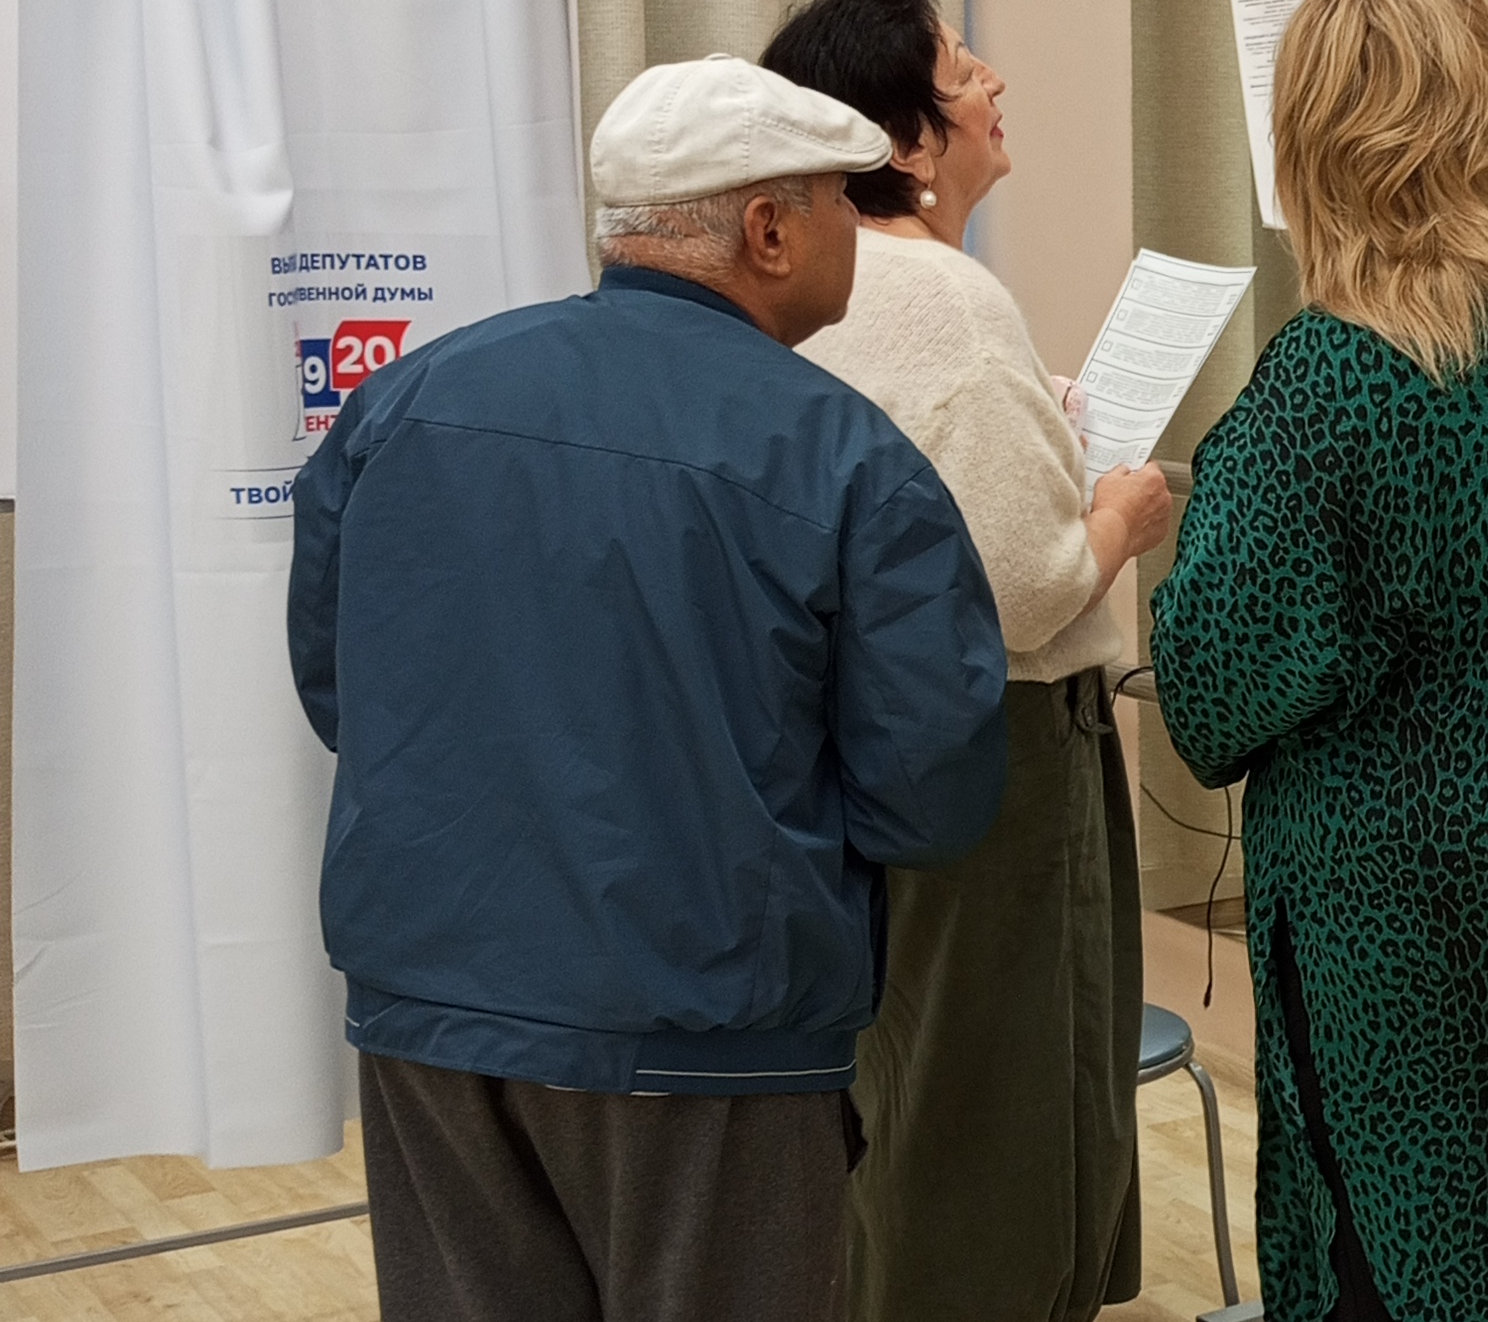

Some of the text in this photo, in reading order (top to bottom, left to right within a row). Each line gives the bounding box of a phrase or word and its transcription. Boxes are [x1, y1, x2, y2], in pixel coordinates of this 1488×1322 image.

[299, 253, 427, 273] ДЕПУТАТОВ
[372, 287, 433, 303] ДУМЫ
[303, 335, 396, 394] 9 20
